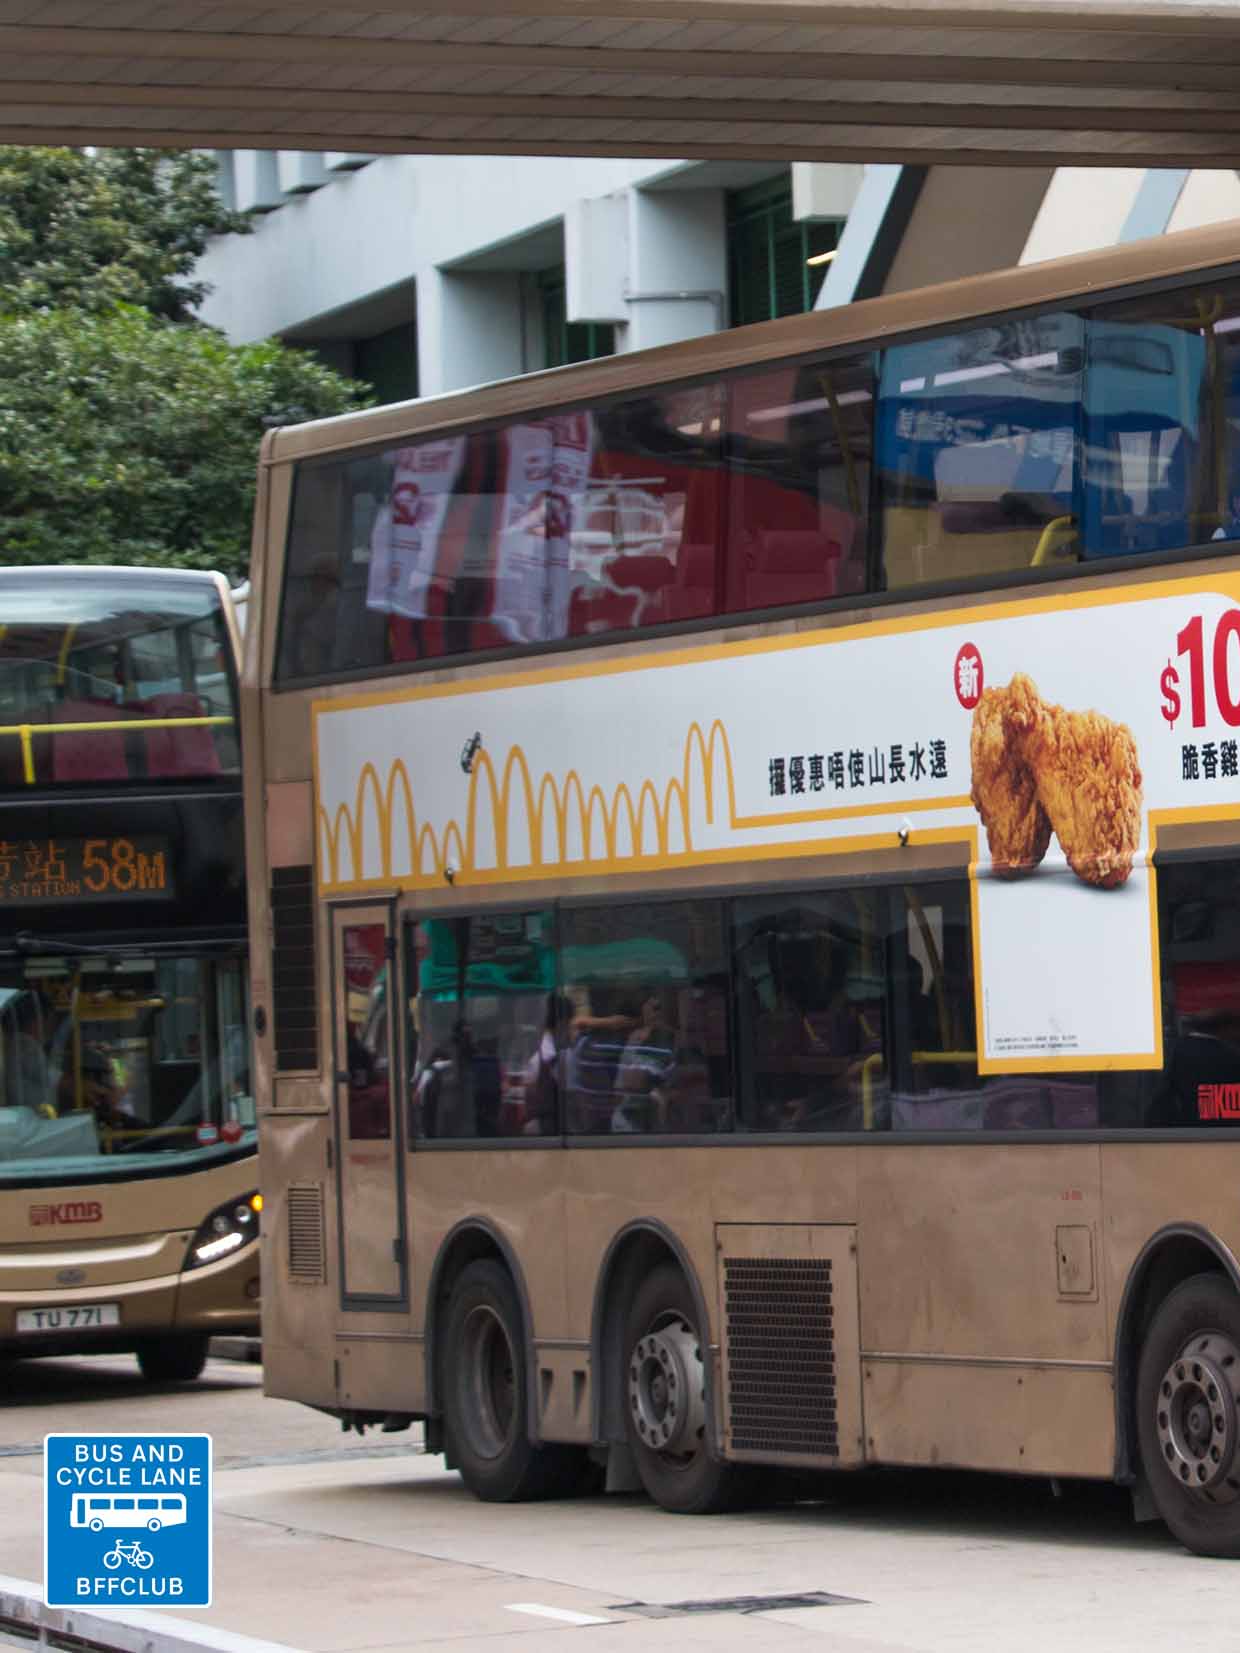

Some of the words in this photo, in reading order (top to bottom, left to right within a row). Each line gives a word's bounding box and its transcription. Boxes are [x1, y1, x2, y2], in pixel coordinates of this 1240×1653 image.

[958, 655, 979, 698] 新
[768, 738, 948, 797] 攞優惠唔使山長水遠
[82, 838, 166, 892] 58M
[48, 1201, 103, 1225] KMB
[32, 1311, 61, 1328] TU
[66, 1308, 102, 1328] 771
